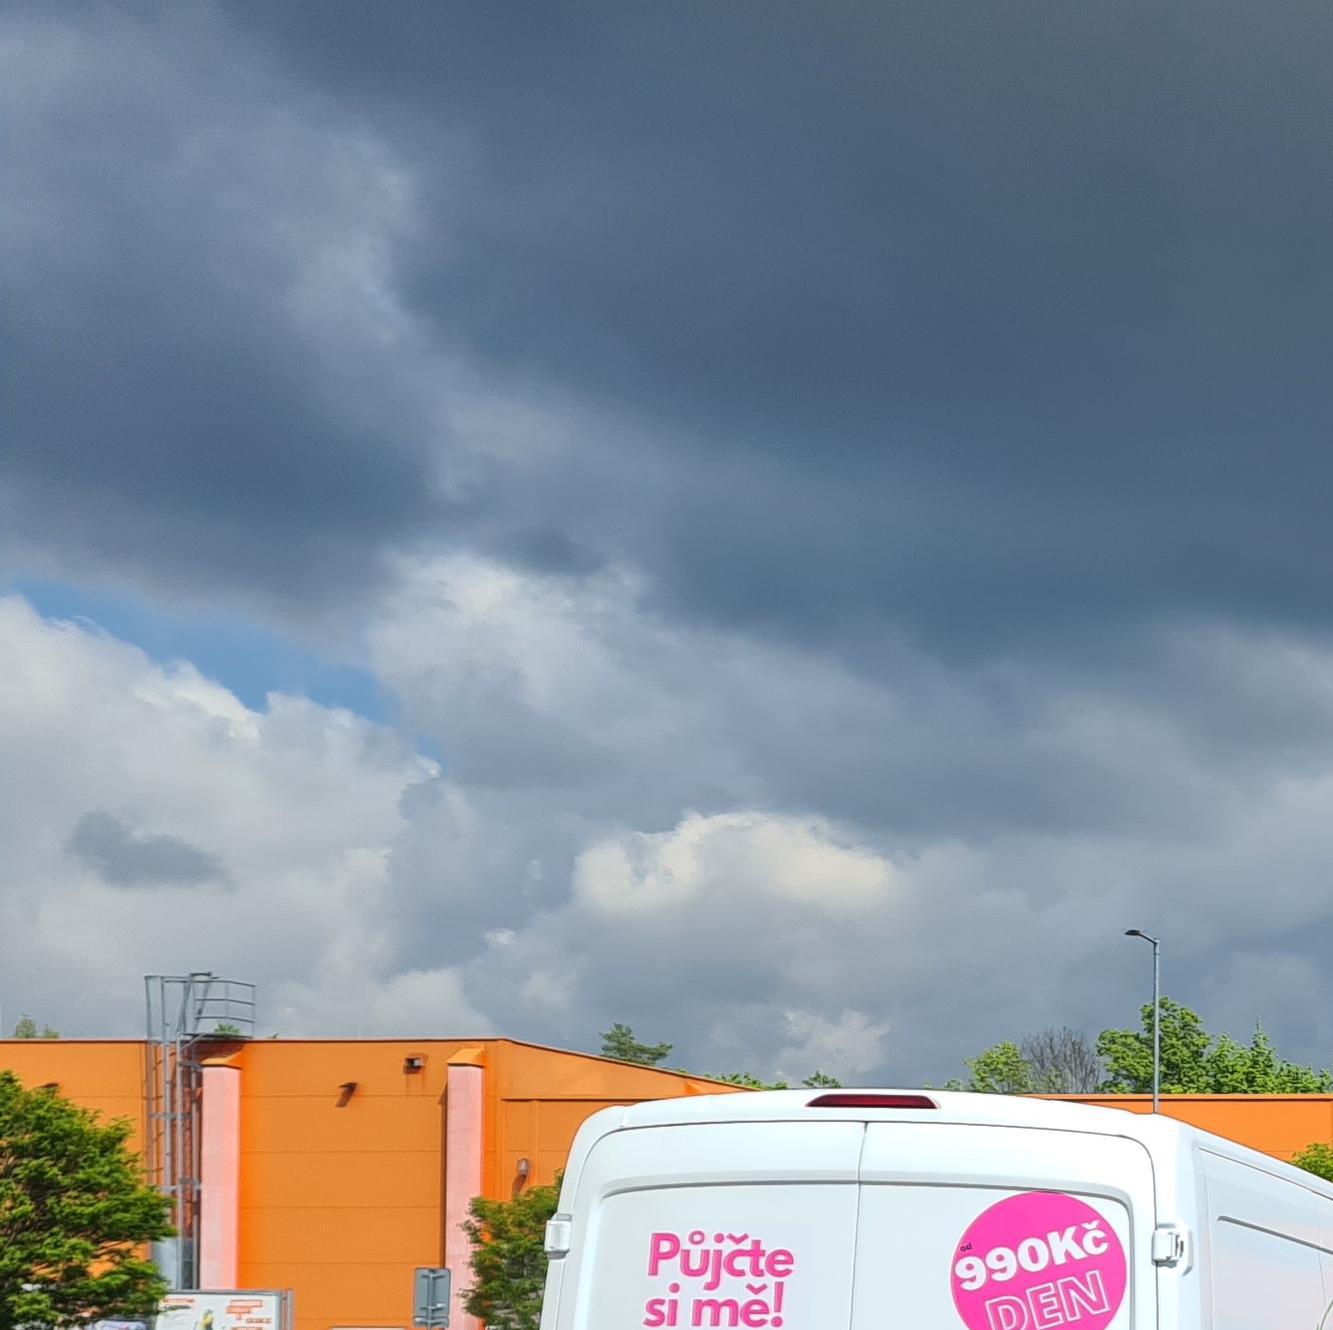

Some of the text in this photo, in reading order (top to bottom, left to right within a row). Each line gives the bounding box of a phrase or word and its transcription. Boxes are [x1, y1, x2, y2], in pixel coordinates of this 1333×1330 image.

[647, 1230, 795, 1291] Půjčte
[954, 1219, 1110, 1292] 990Kč
[960, 1242, 973, 1252] od
[642, 1281, 785, 1328] si mě!
